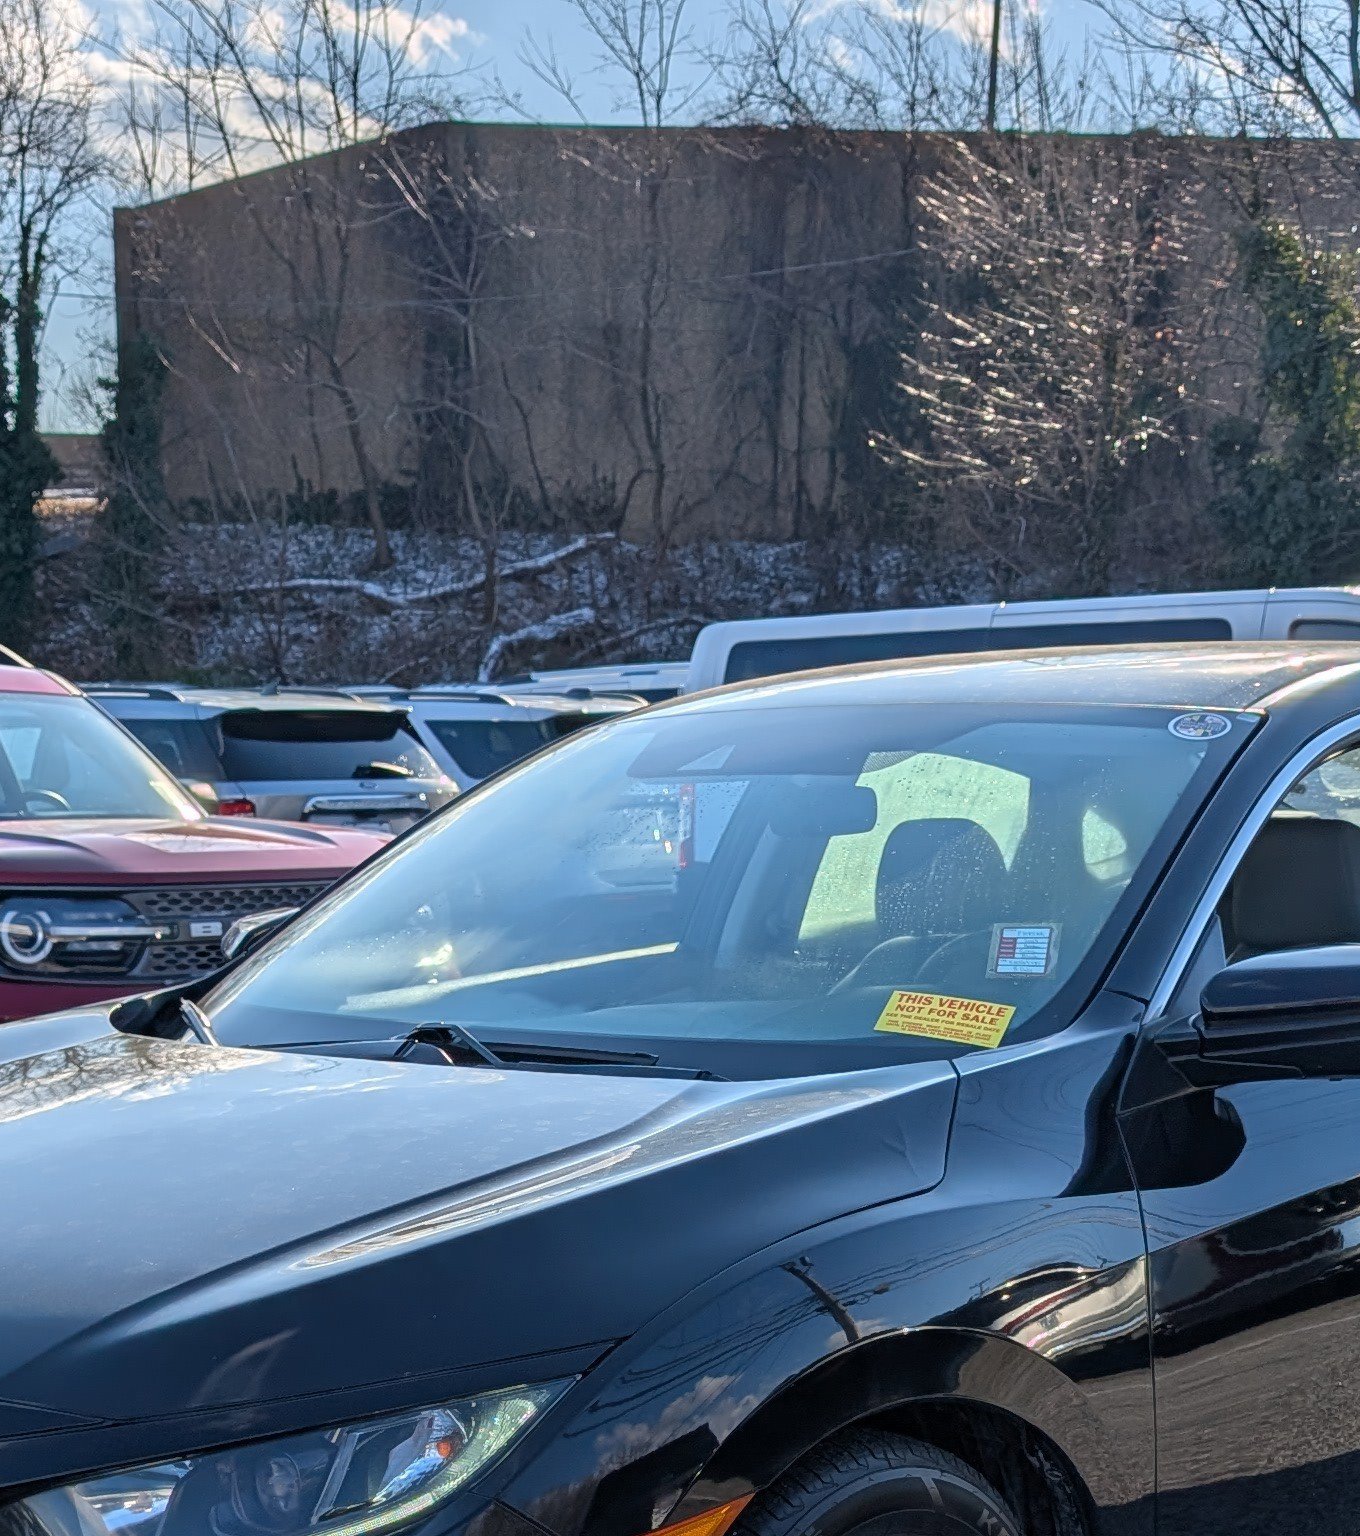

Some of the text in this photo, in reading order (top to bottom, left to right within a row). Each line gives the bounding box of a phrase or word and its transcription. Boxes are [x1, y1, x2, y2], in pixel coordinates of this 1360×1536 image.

[894, 1004, 1000, 1026] NOT FOR SALE
[897, 993, 1009, 1018] THIS VEHICLE
